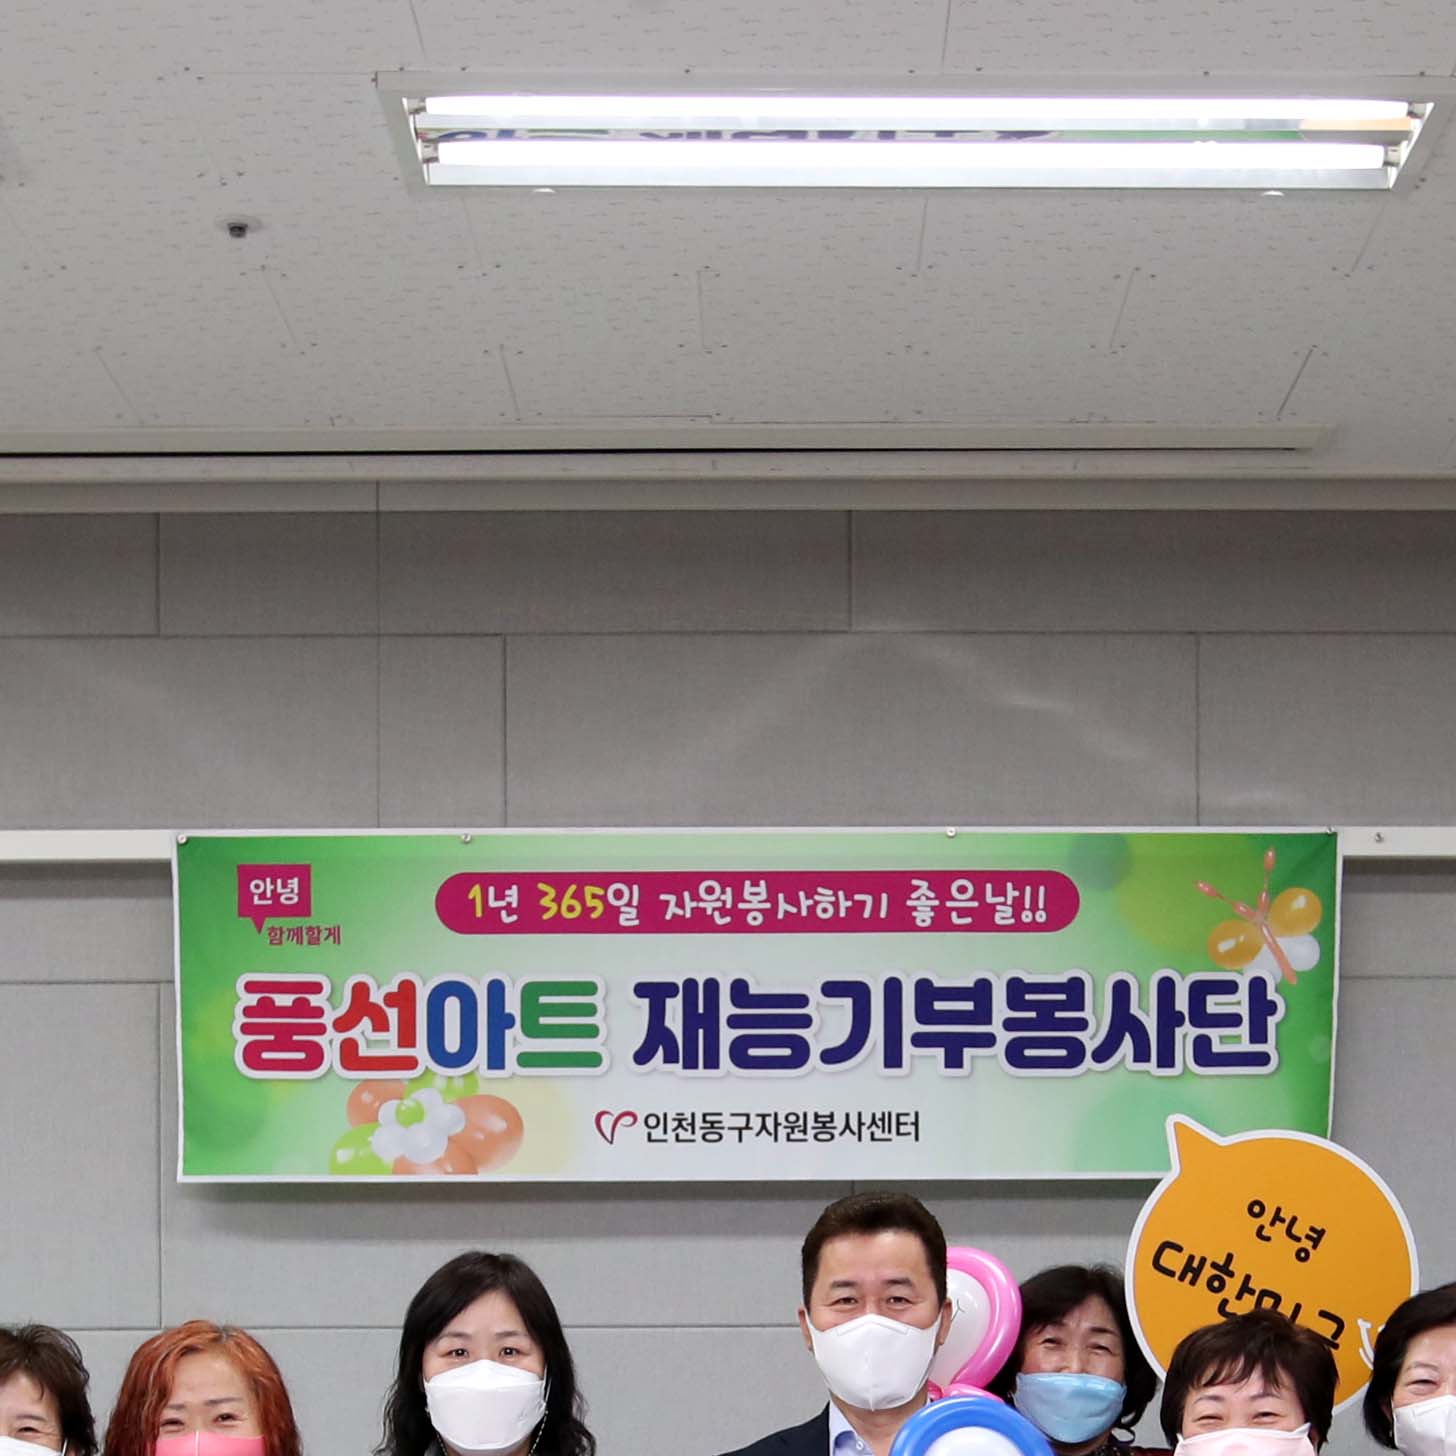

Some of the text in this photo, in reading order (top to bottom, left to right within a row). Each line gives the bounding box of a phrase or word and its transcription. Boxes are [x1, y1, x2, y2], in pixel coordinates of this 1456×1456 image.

[248, 876, 300, 906] 안녕
[467, 879, 1048, 928] 1년 365일 자원봉사하기 좋은날!!
[266, 925, 341, 946] 함께할게
[239, 975, 1279, 1072] 풍선아트 재능기부봉사단
[642, 1110, 921, 1144] 인천동구자원봉사센터
[1246, 1199, 1327, 1263] 안녕
